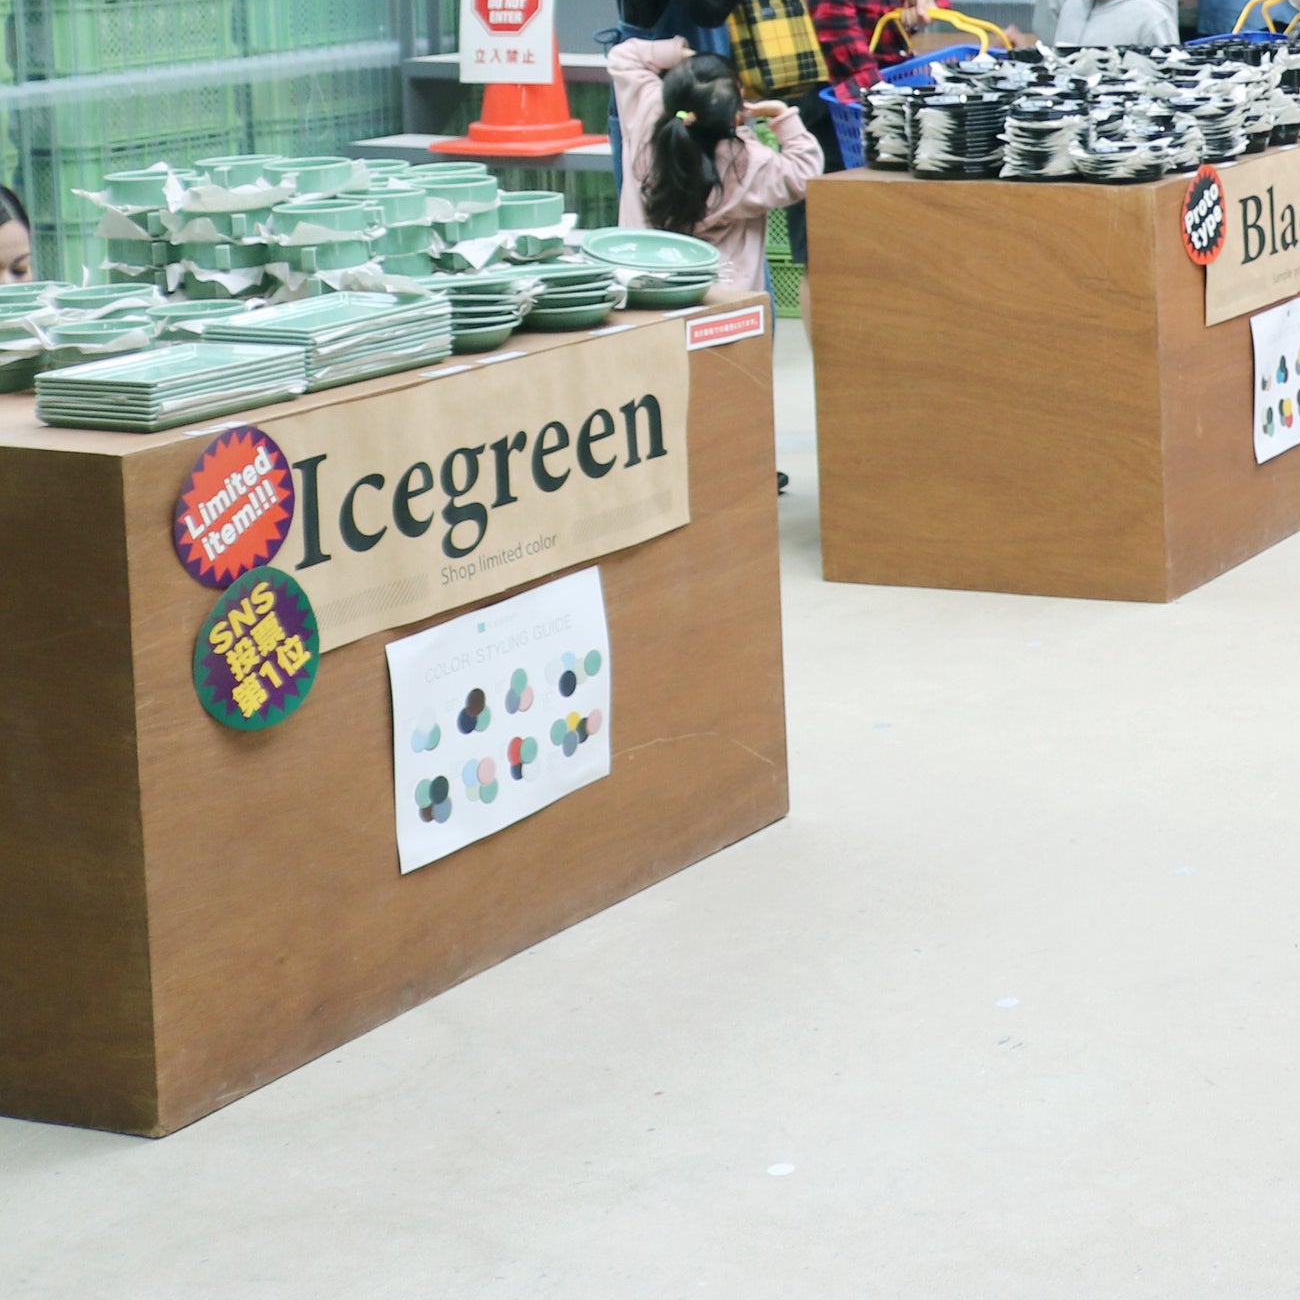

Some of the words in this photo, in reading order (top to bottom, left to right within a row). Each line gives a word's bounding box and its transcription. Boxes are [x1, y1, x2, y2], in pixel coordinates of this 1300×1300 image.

[488, 10, 523, 24] ENTER
[474, 48, 535, 64] 立入禁止
[1184, 183, 1219, 234] Proto
[1191, 205, 1222, 249] type
[184, 445, 274, 541] Limited
[292, 393, 667, 571] Icegreen
[201, 479, 278, 562] item!!!
[440, 564, 476, 585] Shop
[478, 541, 523, 572] limited
[525, 533, 558, 556] color
[209, 581, 276, 655] SNS
[226, 610, 286, 682] 投票
[424, 652, 471, 683] COLOR
[476, 630, 528, 665] STYLING
[532, 614, 572, 641] GUIDE
[231, 634, 312, 719] 第1位
